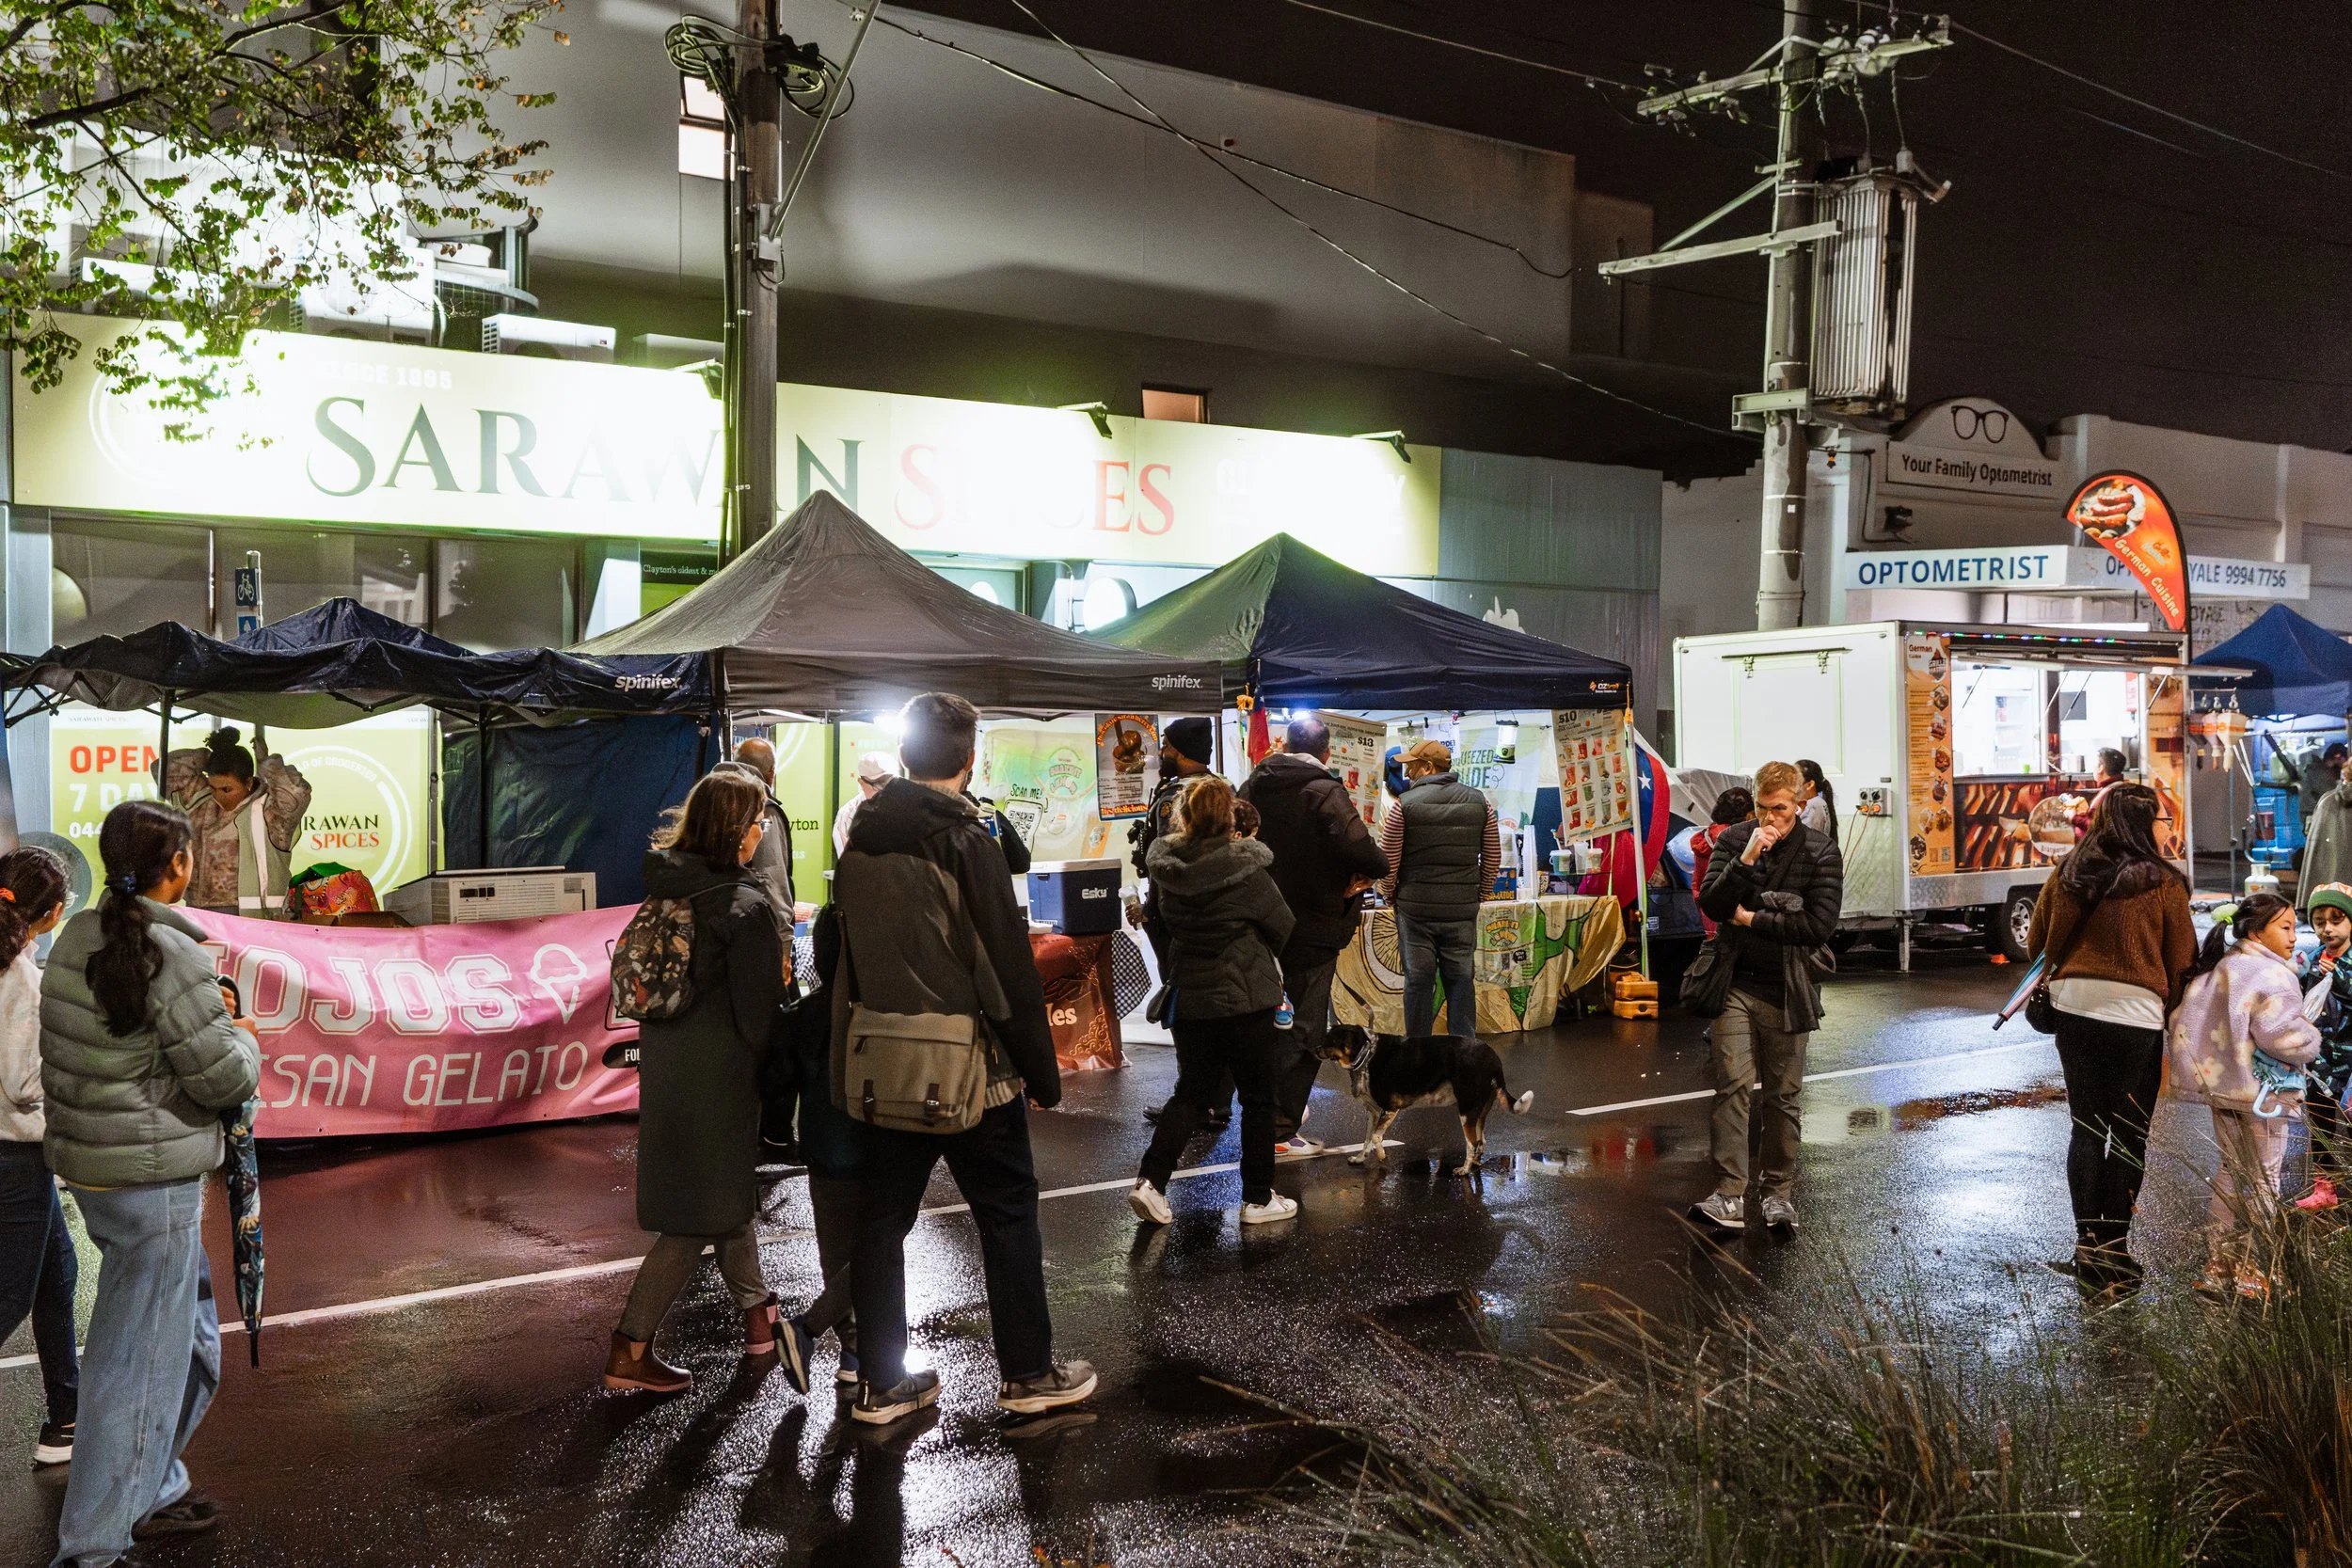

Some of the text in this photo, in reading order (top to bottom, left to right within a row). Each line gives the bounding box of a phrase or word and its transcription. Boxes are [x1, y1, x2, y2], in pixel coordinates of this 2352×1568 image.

[1902, 453, 2052, 486] Your Family Optometrist
[643, 564, 677, 576] Clayton's
[1858, 555, 2049, 585] OPTOMETRIST
[2114, 538, 2152, 578] German
[2151, 576, 2180, 618] Cuisine
[2226, 565, 2254, 586] 9994
[2257, 568, 2287, 588] 7756
[614, 673, 681, 692] spinifex
[1152, 674, 1201, 690] spinifex
[1558, 710, 1578, 724] $10
[1358, 736, 1374, 748] $13
[69, 783, 87, 813] 7
[310, 832, 380, 851] SPICES
[1082, 887, 1106, 900] Esky
[403, 1040, 589, 1107] GELATO
